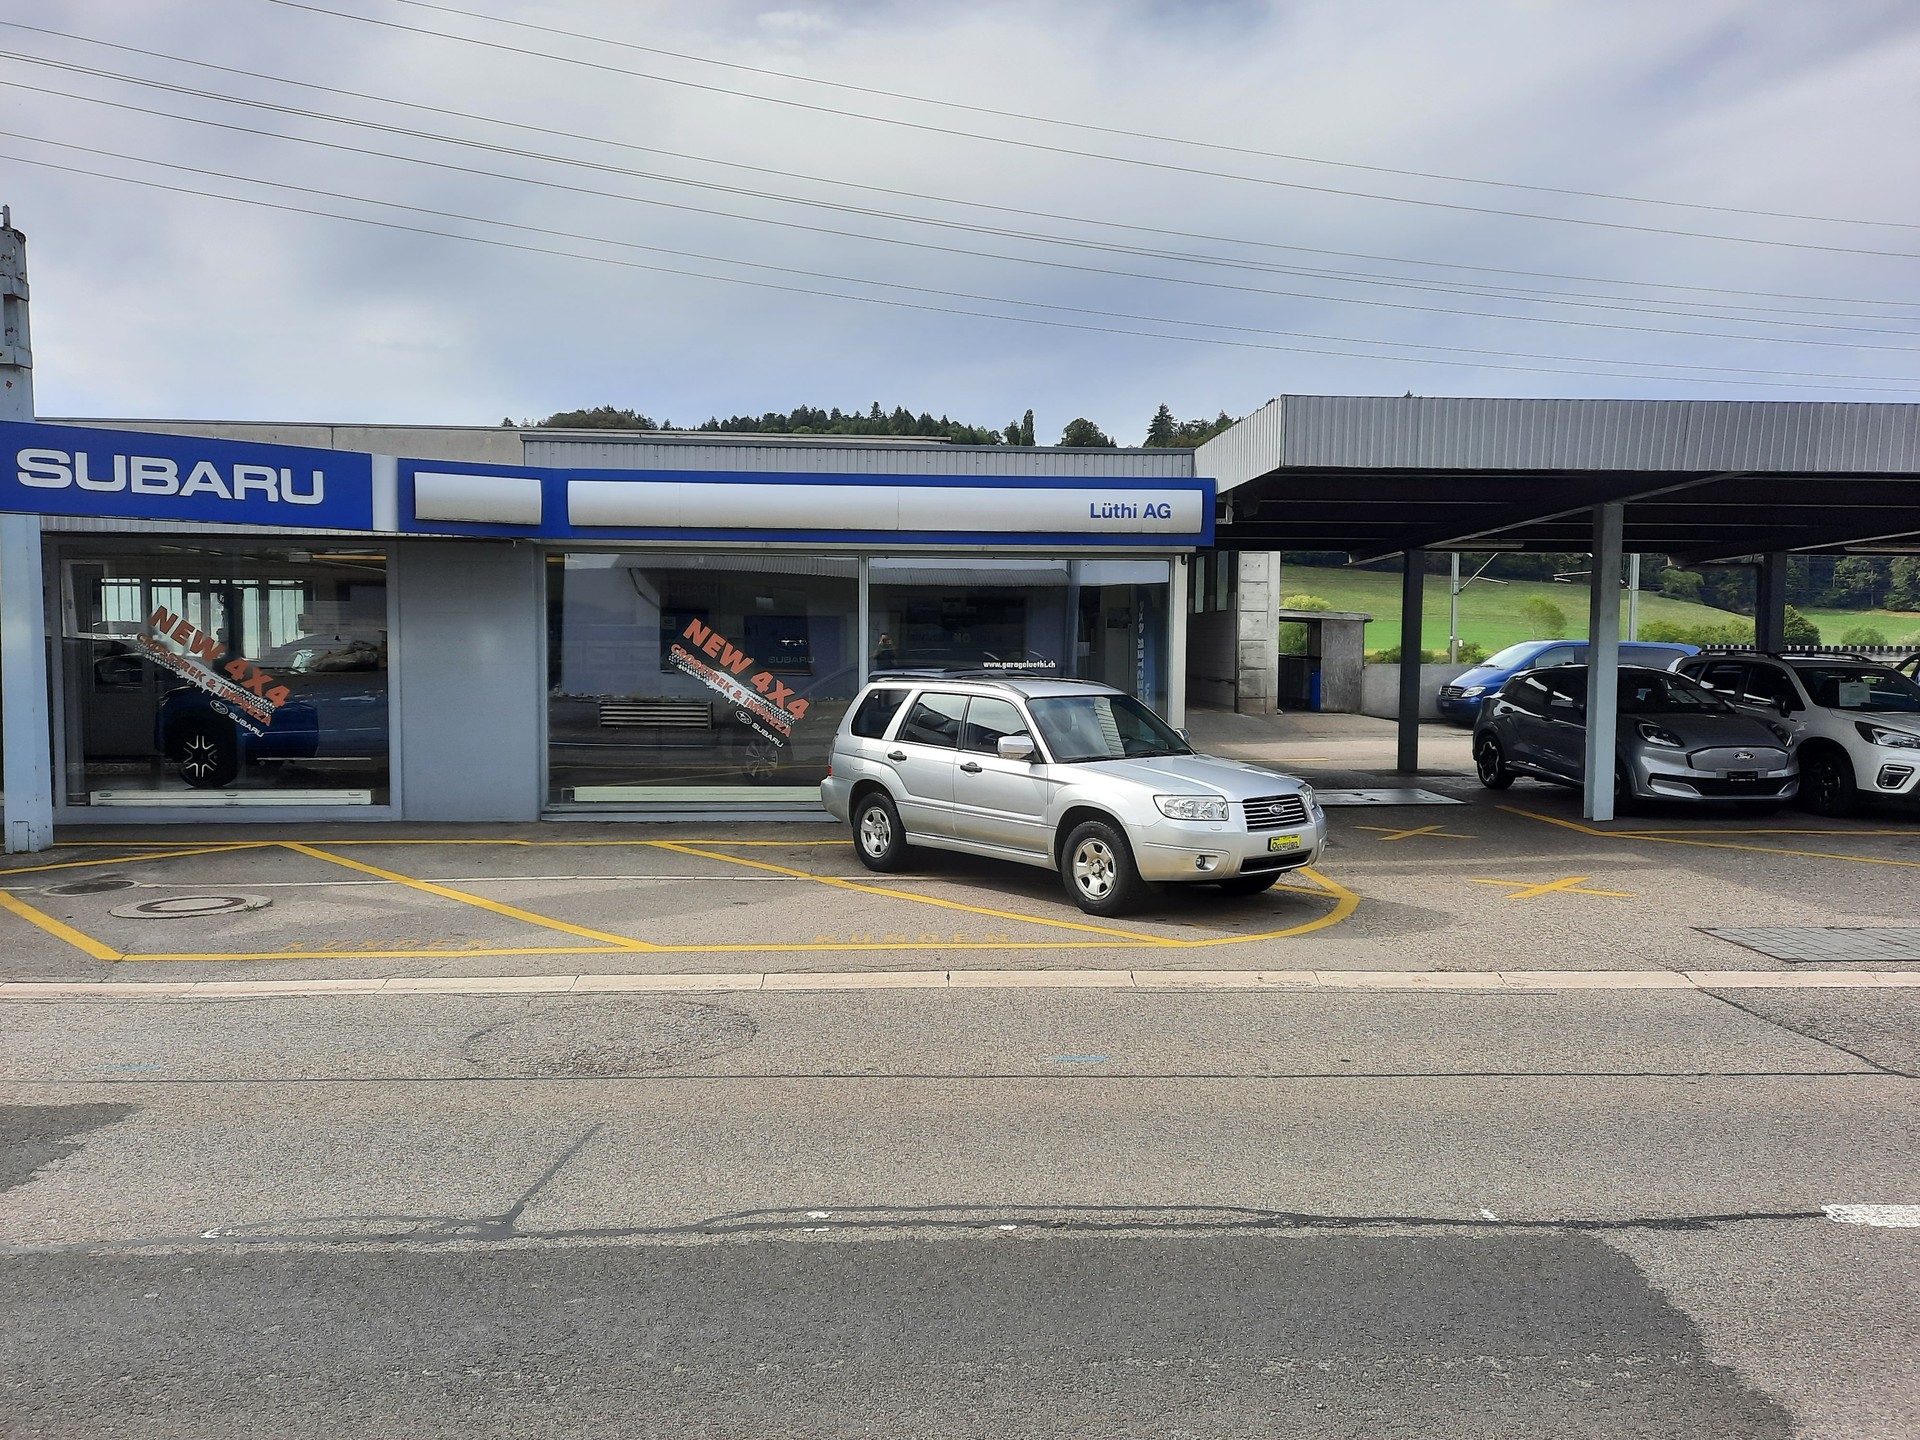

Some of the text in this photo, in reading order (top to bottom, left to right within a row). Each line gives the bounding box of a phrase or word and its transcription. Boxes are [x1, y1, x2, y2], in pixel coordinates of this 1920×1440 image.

[16, 448, 325, 505] SUBARU
[1090, 503, 1172, 519] Lüthi AG
[150, 605, 290, 708] NEW 4X4
[683, 618, 810, 720] NEW 4X4
[768, 656, 815, 664] SUBARU
[206, 679, 216, 690] &
[218, 685, 272, 726] IMPREZA
[228, 712, 265, 738] SUBARU
[733, 690, 743, 700] &
[743, 696, 792, 737] IMPREZA
[751, 722, 784, 748] SUBARU
